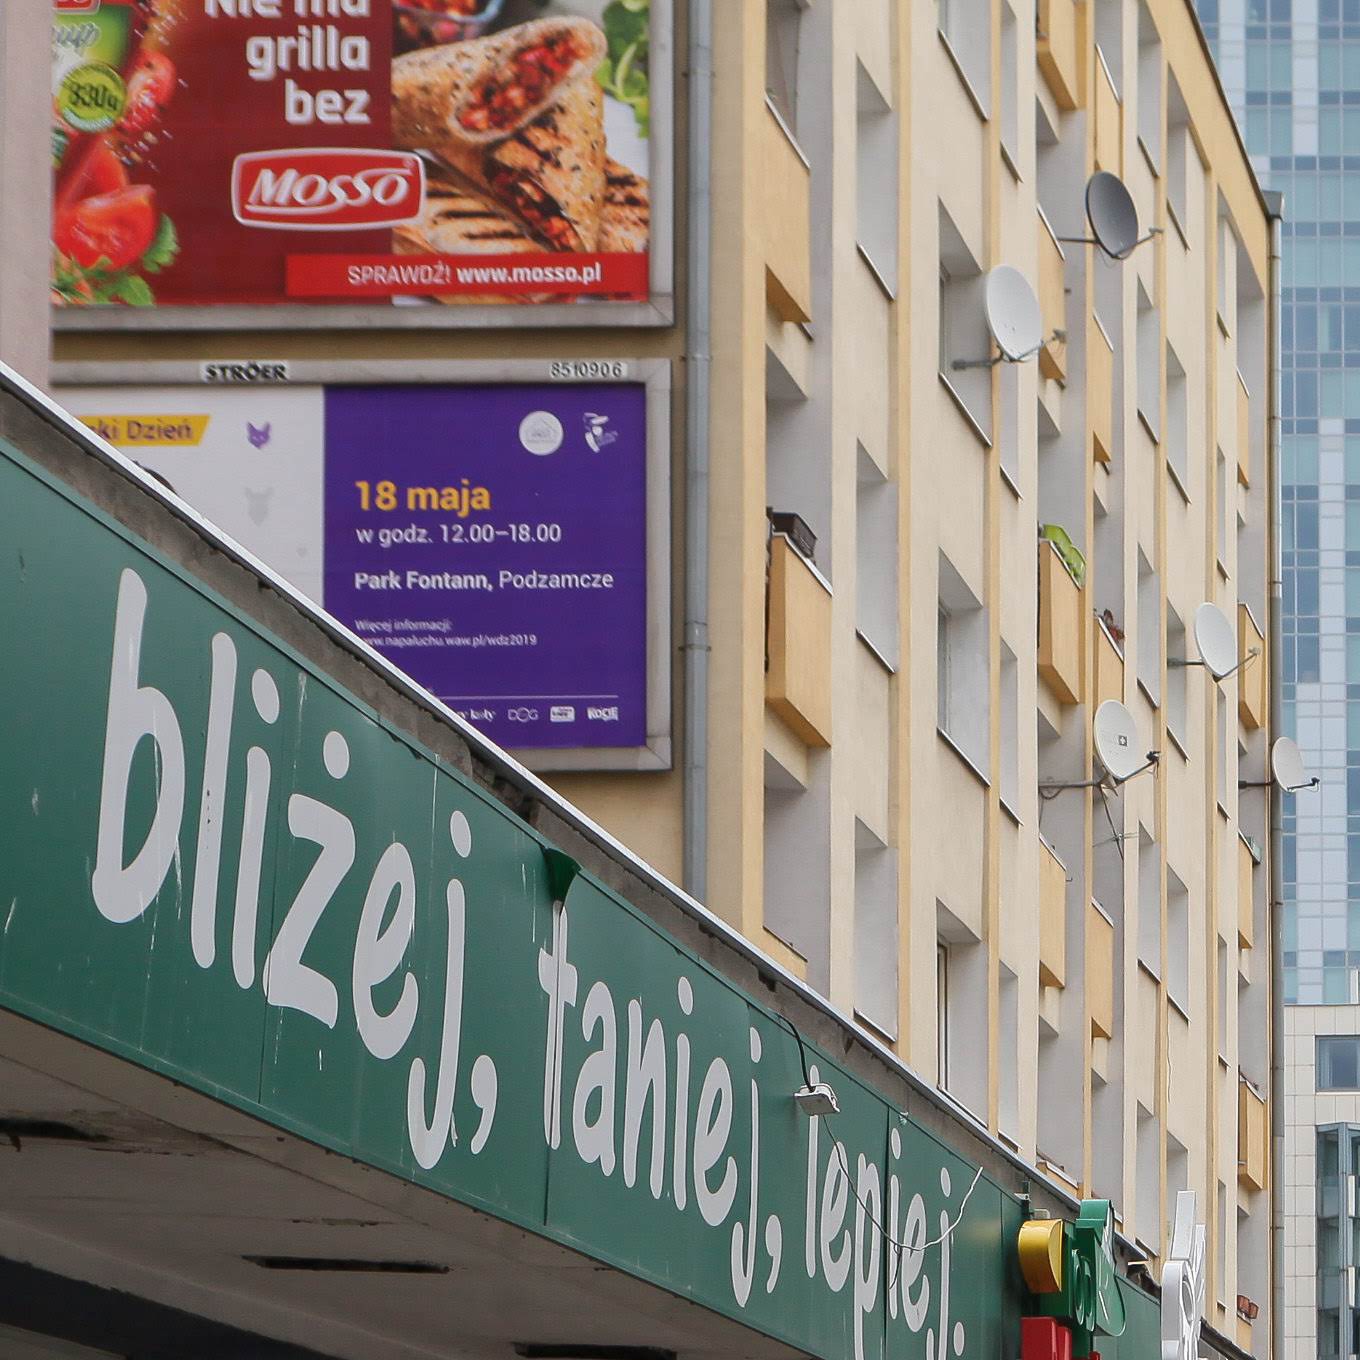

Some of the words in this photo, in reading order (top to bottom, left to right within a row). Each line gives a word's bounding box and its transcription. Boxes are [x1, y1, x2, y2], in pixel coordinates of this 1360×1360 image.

[246, 27, 370, 81] grilla
[285, 79, 371, 124] bez
[347, 263, 452, 286] SPRAWDŹ!
[456, 261, 602, 286] www.mosso.pl
[206, 361, 288, 382] STRÖER
[550, 362, 623, 379] 8510906
[126, 418, 194, 441] Dzień
[355, 481, 396, 511] 18
[407, 480, 491, 518] maja
[356, 528, 373, 544] w
[378, 524, 432, 548] godz.
[354, 570, 402, 591] Park
[406, 570, 494, 594] Fontann,
[499, 568, 614, 590] Podzamcze
[355, 620, 393, 633] Więcej
[91, 569, 498, 1170] bliżej,
[537, 899, 784, 1309] taniej,
